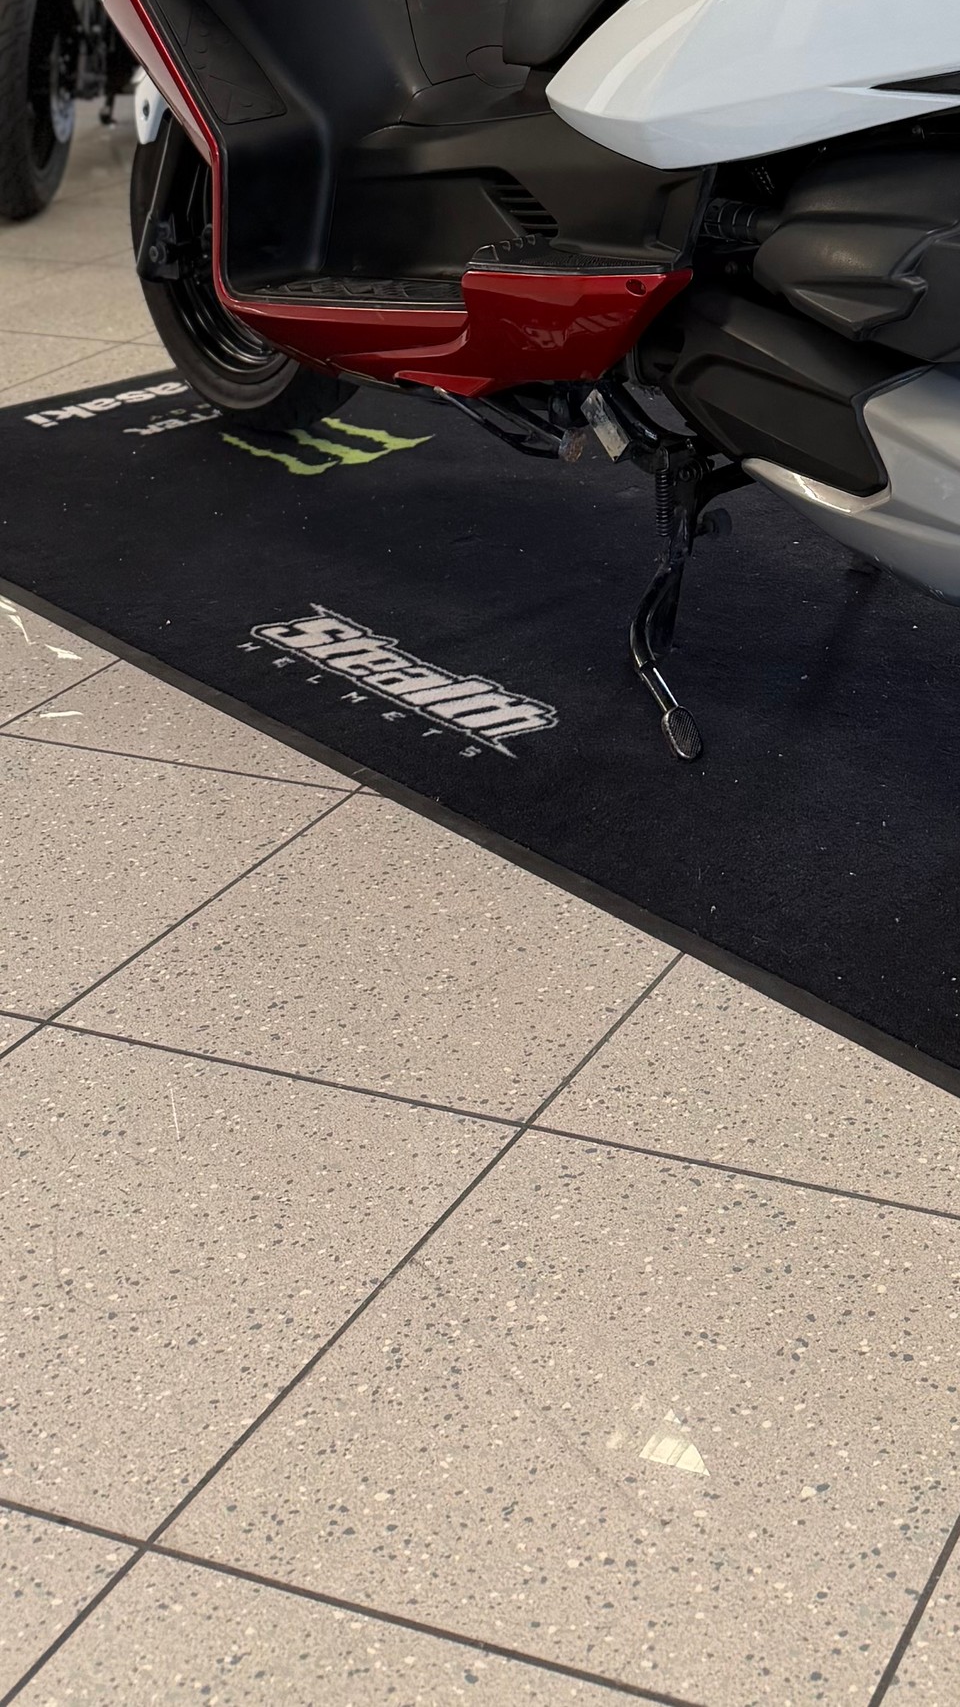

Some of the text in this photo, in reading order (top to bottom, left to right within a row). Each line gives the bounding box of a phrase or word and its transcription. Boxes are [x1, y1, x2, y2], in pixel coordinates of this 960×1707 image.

[24, 381, 190, 429] asaki
[237, 641, 483, 759] HELMETS
[251, 608, 558, 750] Stealth
